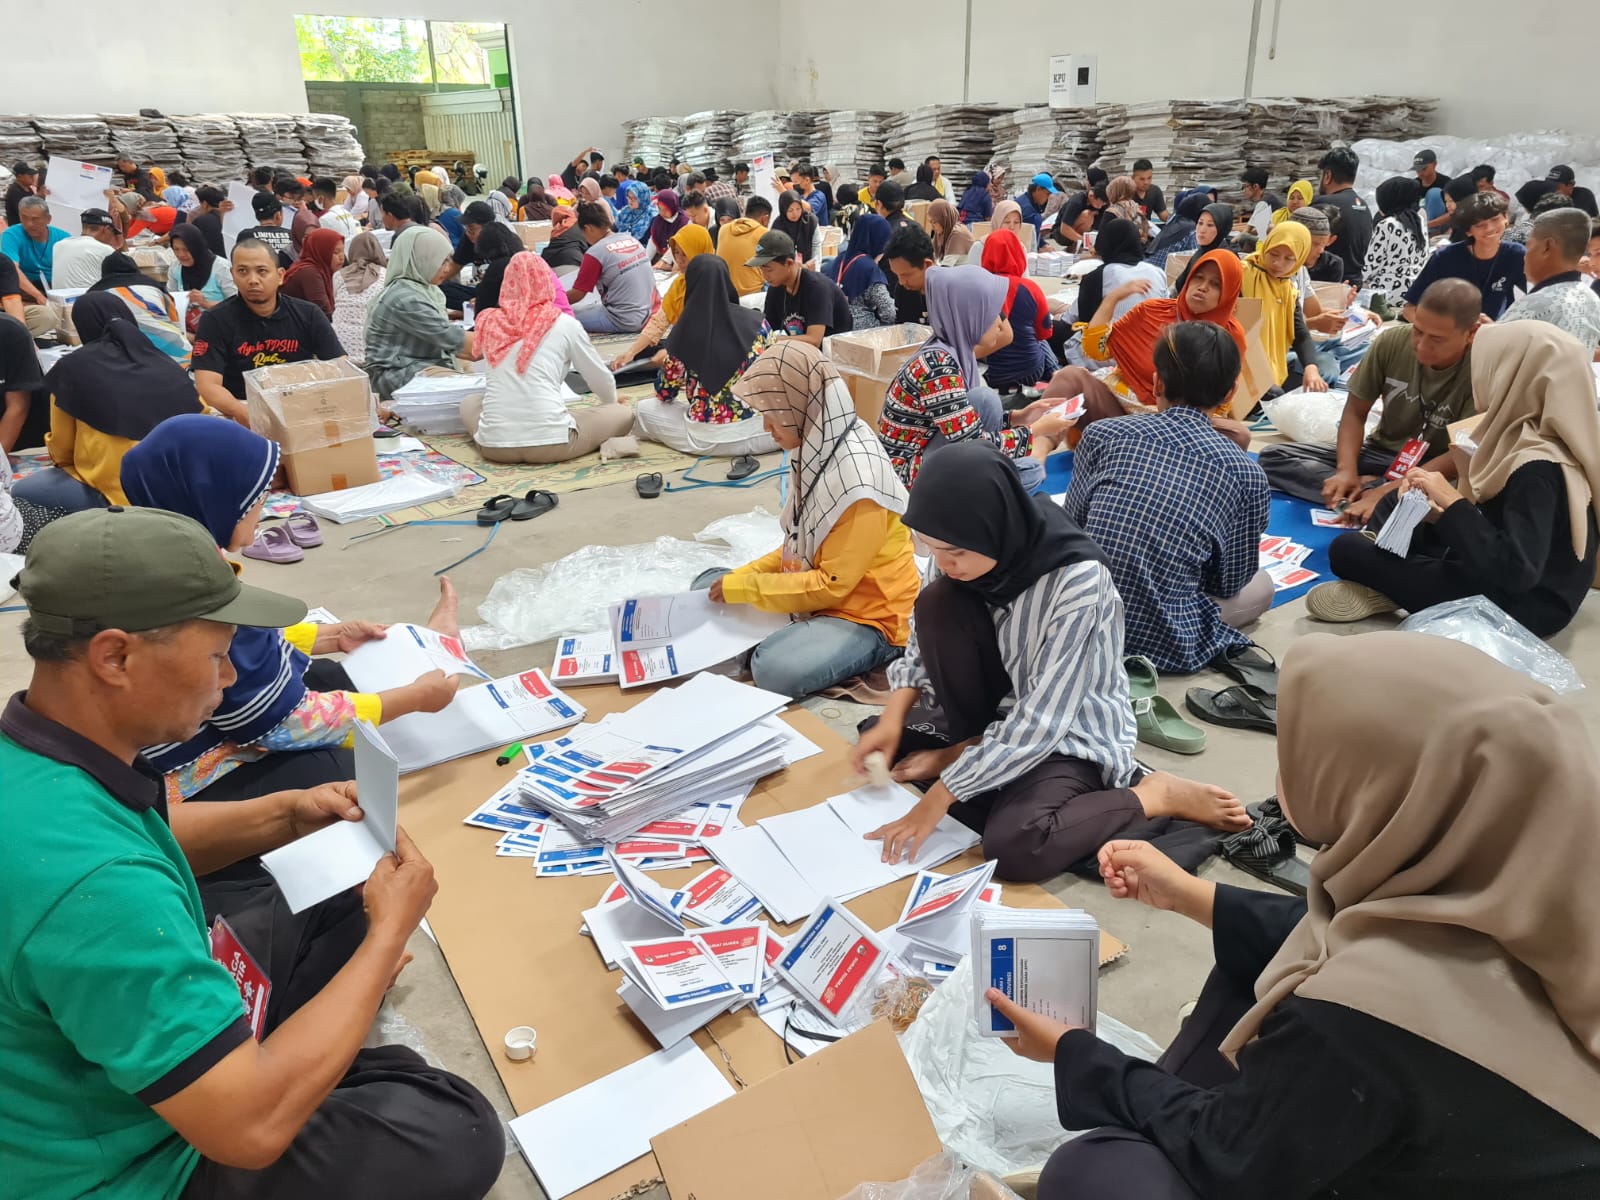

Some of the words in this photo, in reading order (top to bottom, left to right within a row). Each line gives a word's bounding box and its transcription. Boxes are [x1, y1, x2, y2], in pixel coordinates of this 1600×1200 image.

[1053, 73, 1066, 83] KPU
[253, 231, 290, 239] LIMITLESS
[264, 339, 299, 352] TPS!!!
